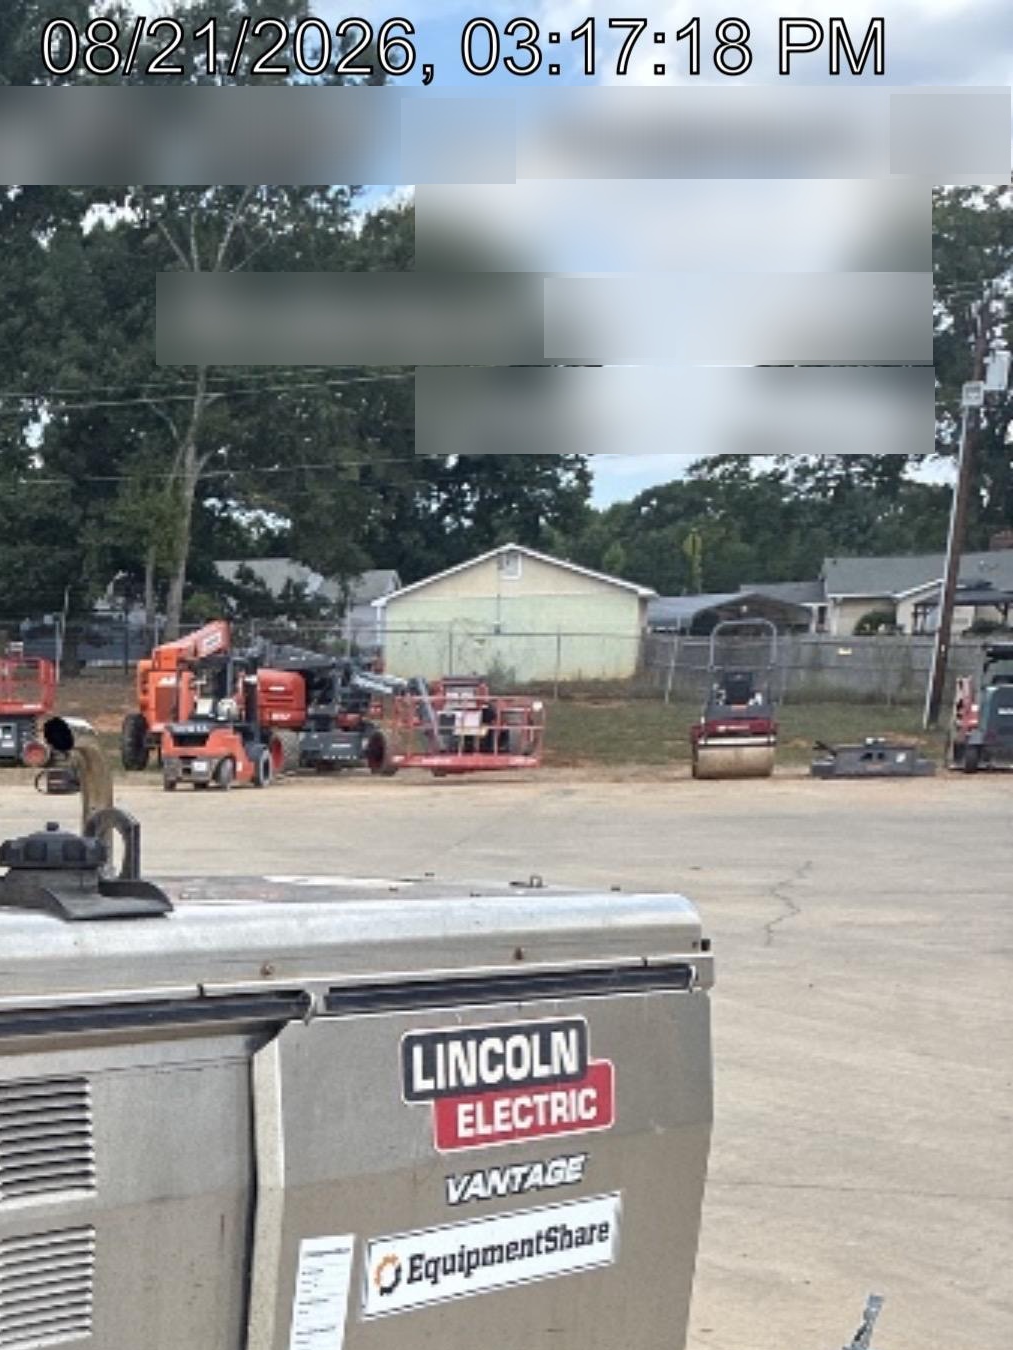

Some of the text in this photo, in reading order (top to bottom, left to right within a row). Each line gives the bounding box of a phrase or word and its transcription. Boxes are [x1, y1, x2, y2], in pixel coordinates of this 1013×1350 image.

[412, 1028, 579, 1093] LINCOLN
[456, 1088, 598, 1139] ELECTRIC
[445, 1153, 589, 1206] VANTAGE
[406, 1221, 610, 1285] EquipmentShare
